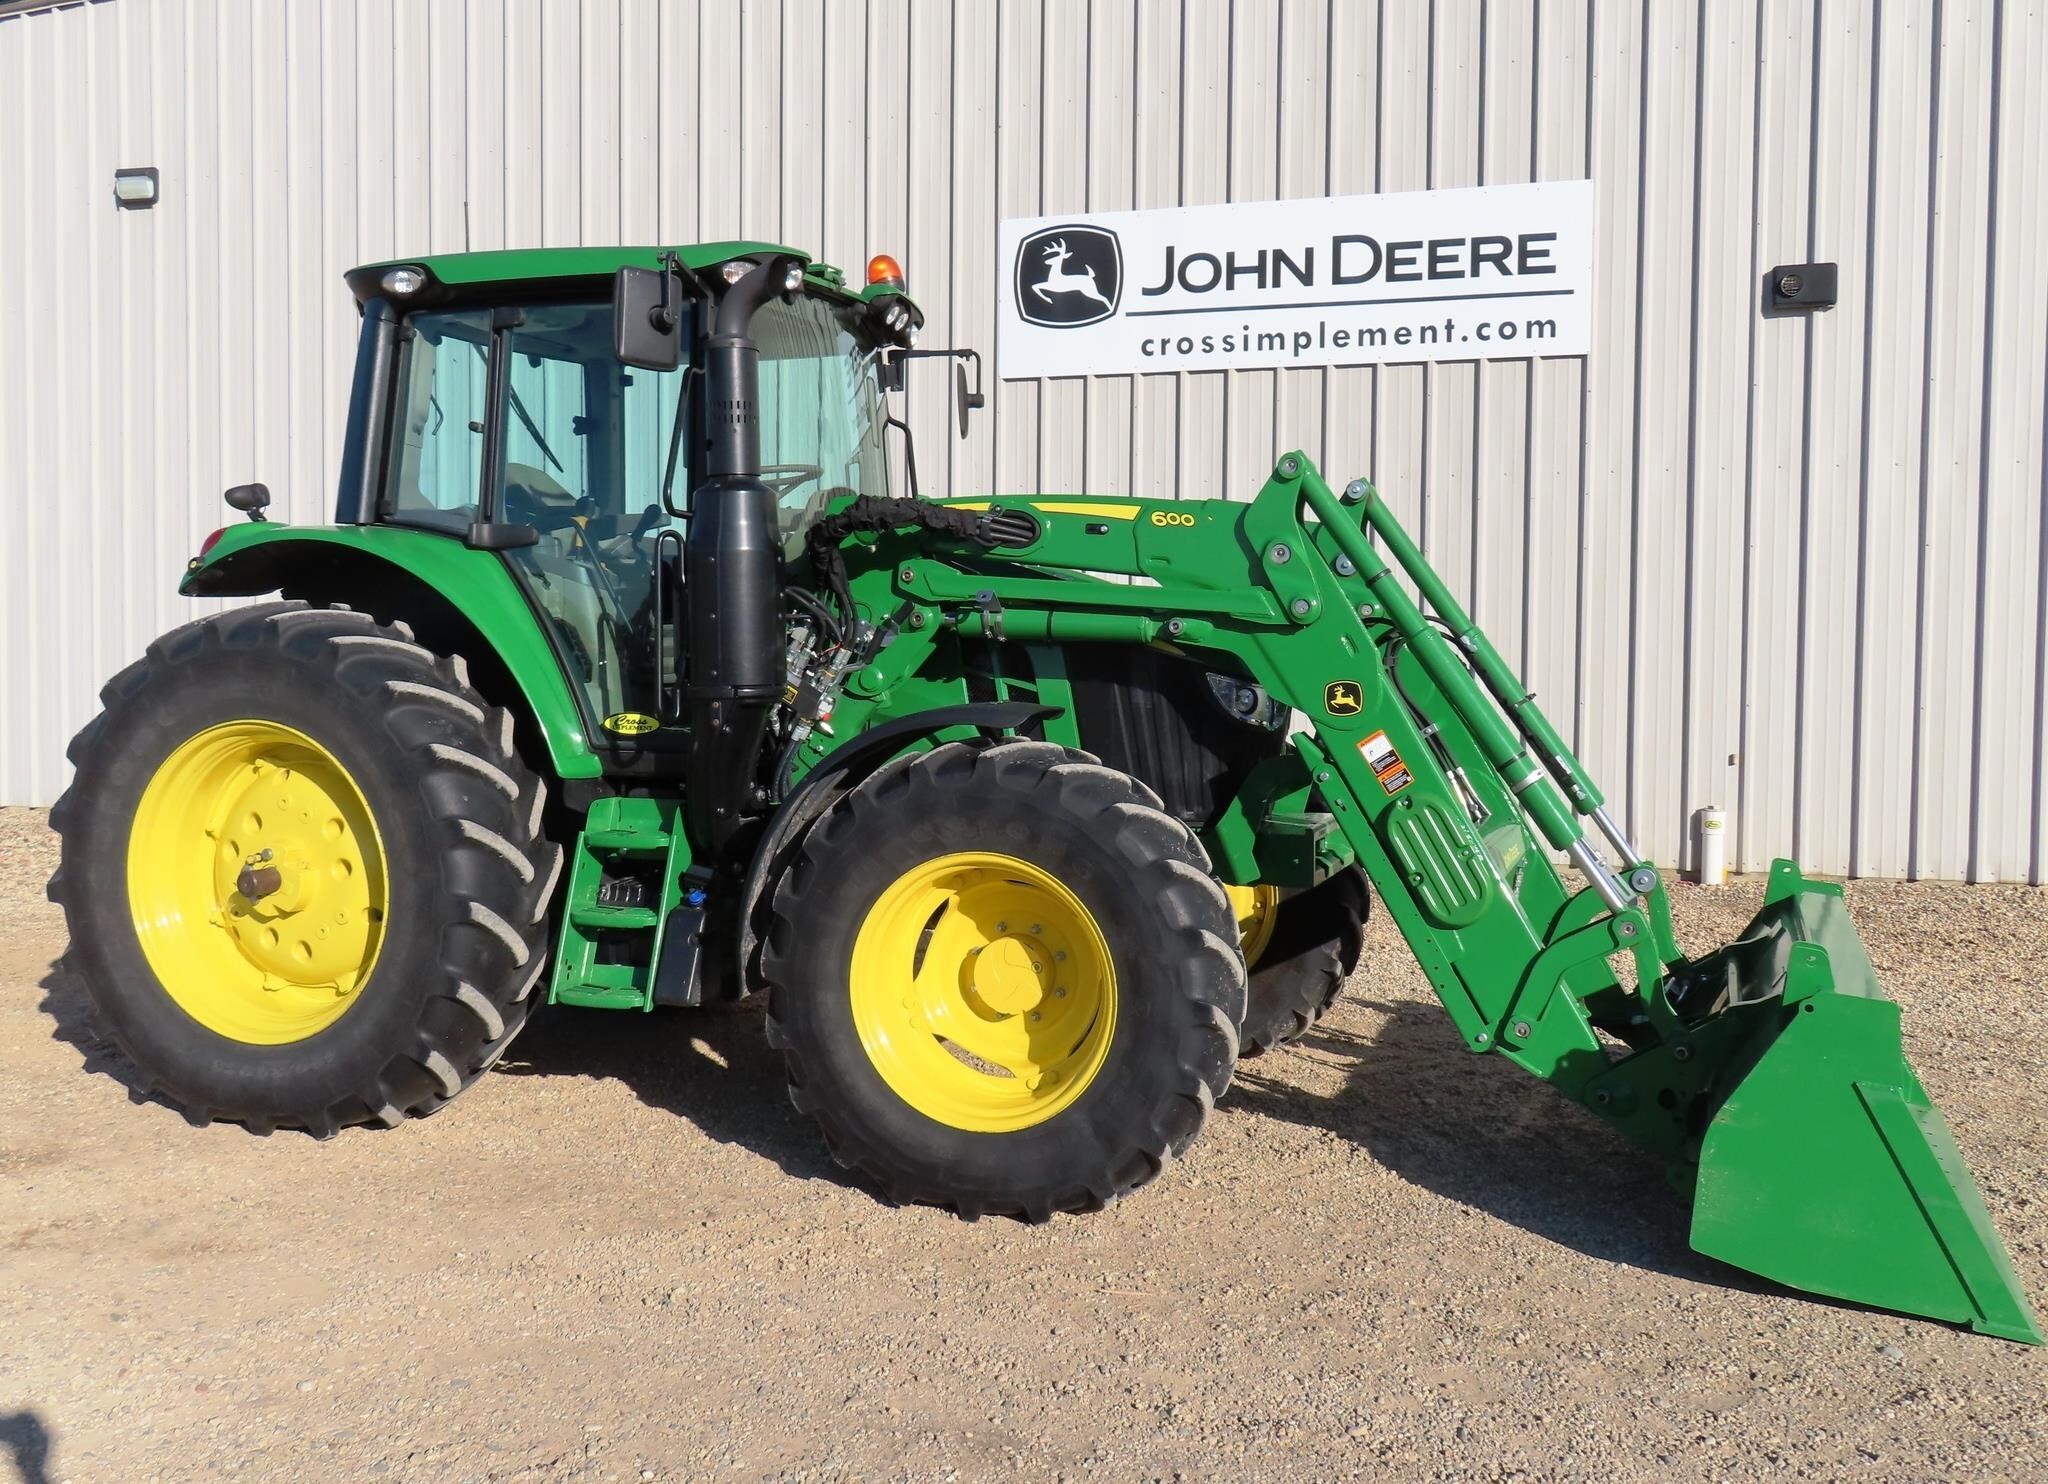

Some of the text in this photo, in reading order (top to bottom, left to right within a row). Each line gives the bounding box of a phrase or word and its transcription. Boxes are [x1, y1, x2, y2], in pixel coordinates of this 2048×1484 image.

[1142, 232, 1557, 297] JOHN DEERE
[1140, 318, 1558, 357] crossimplement.com
[1151, 511, 1195, 527] 600
[614, 715, 647, 725] Cross
